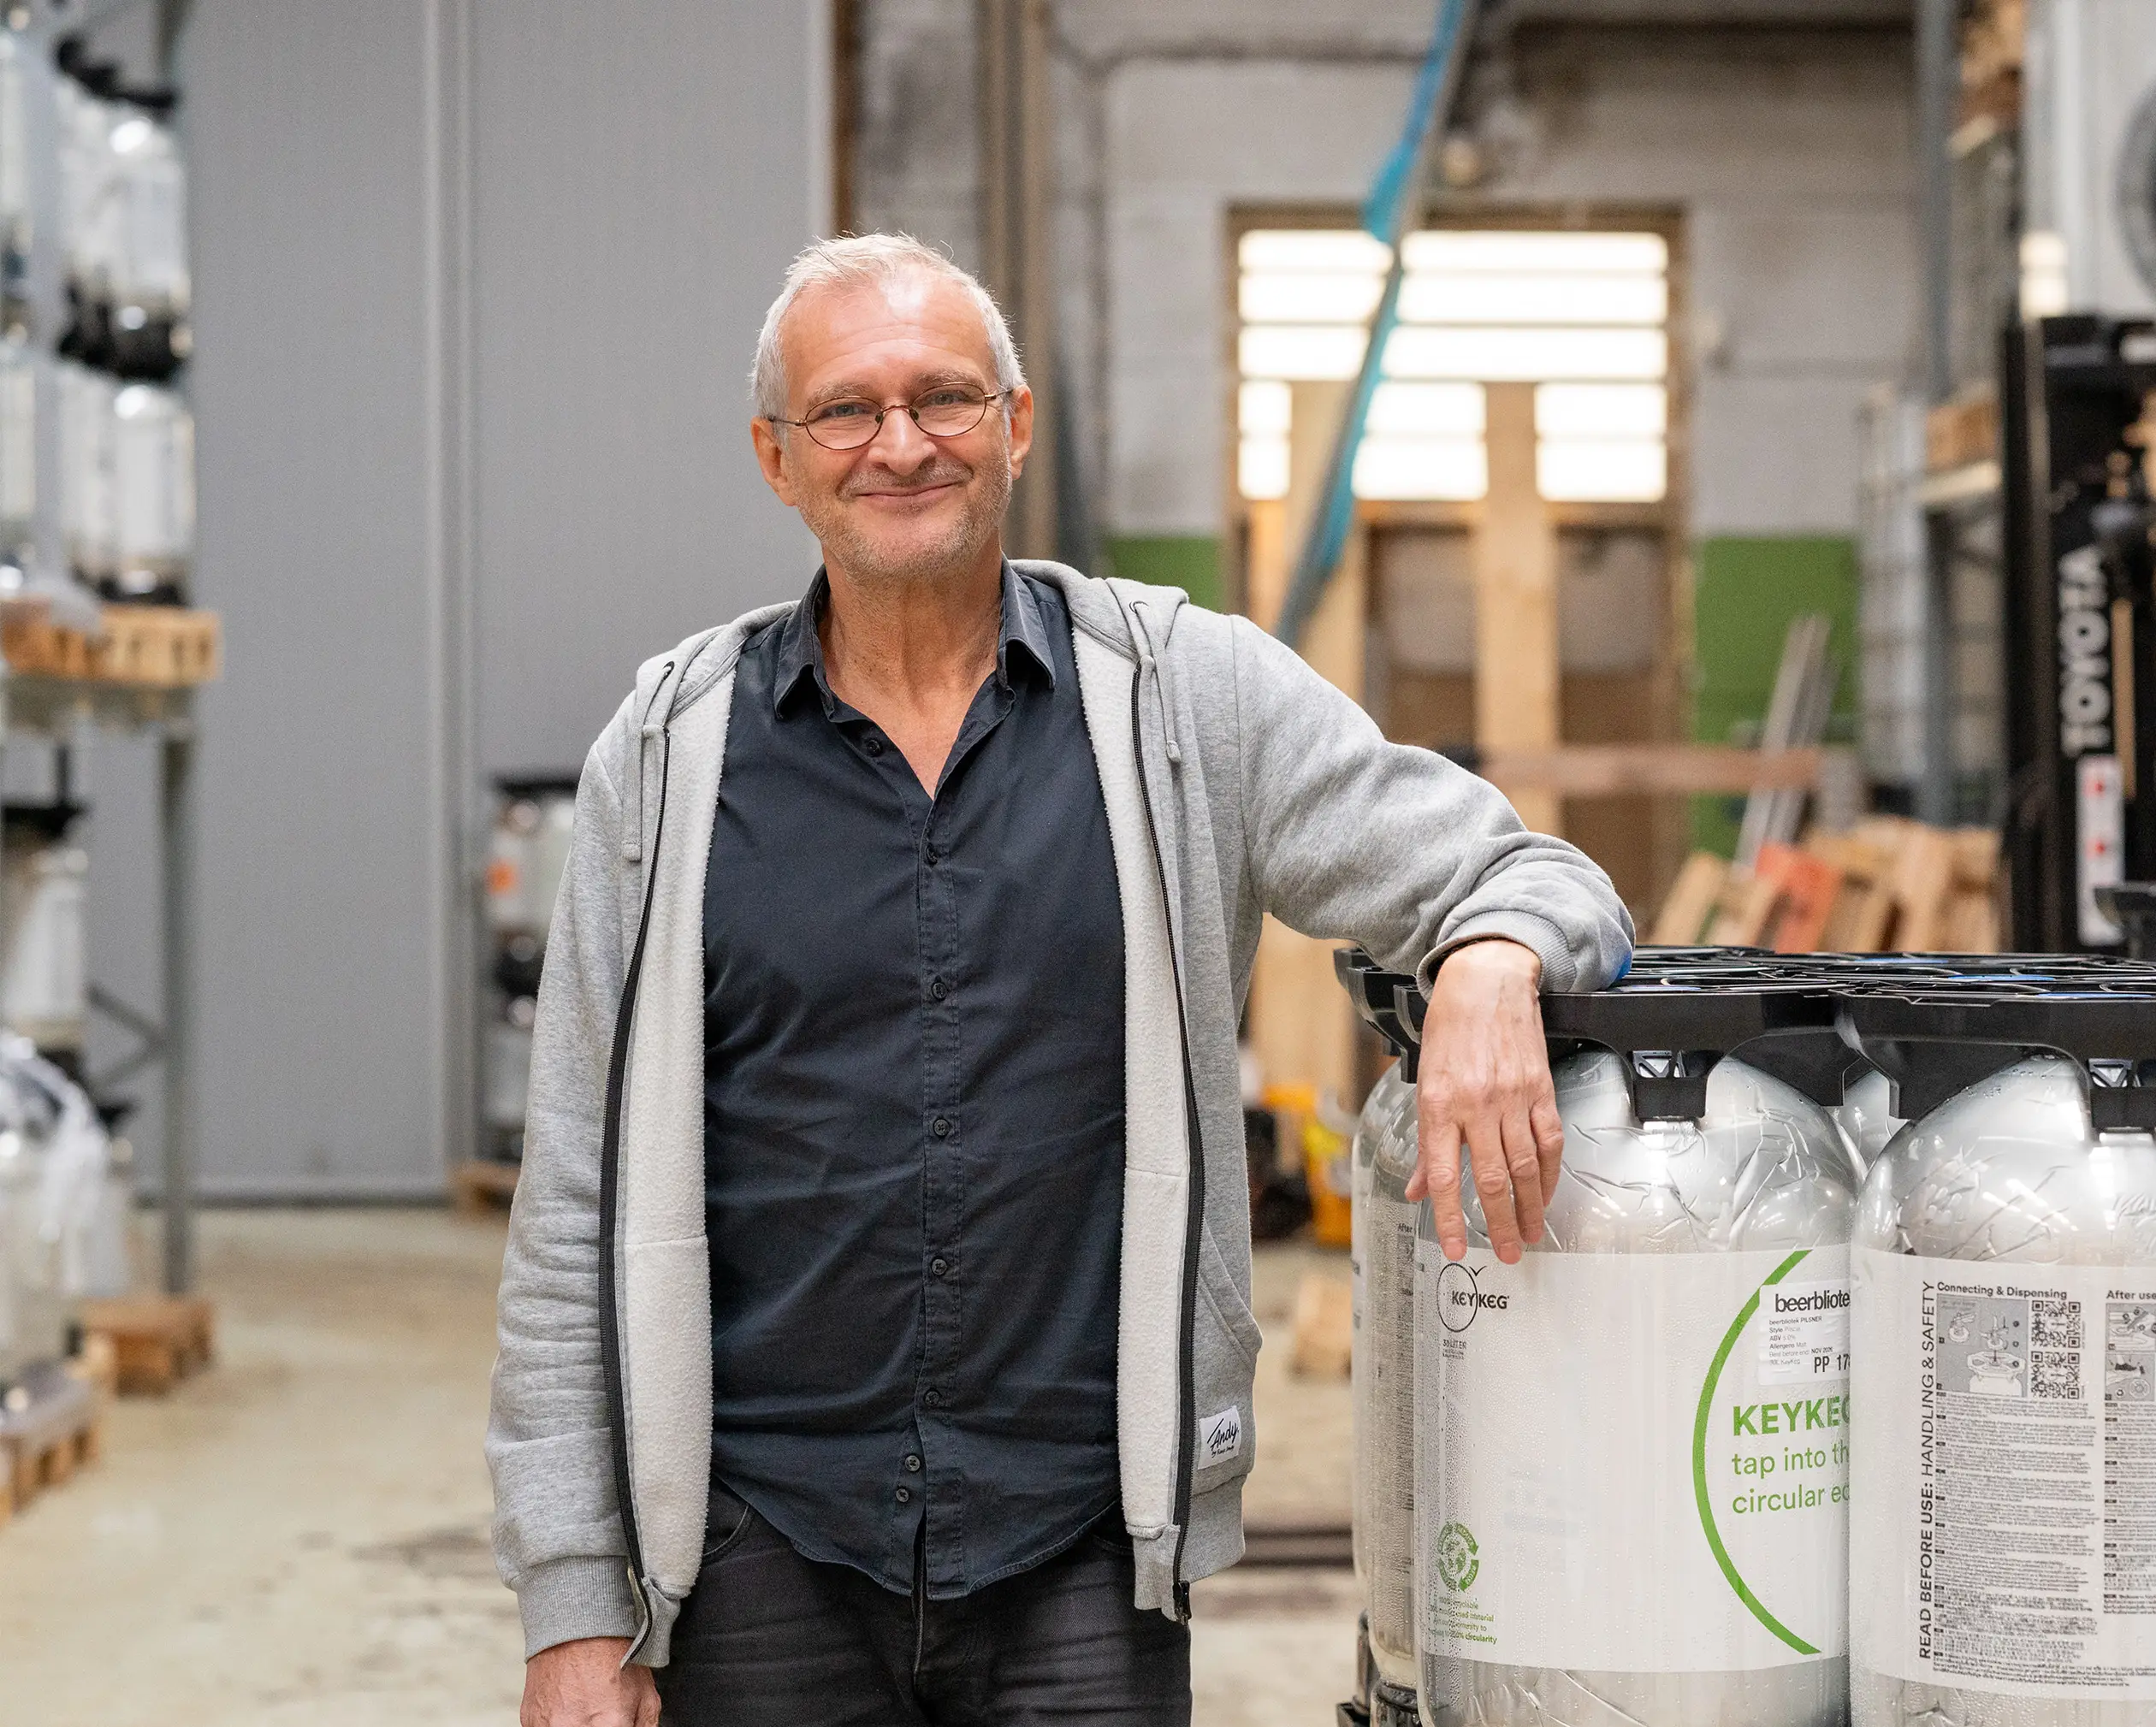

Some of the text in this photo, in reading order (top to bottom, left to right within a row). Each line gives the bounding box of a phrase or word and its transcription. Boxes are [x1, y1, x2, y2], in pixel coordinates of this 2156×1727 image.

[2058, 545, 2111, 758] TOYOTA
[1937, 1281, 2067, 1300] Connecting & Dispensing
[2106, 1289, 2156, 1300] After use
[1814, 1355, 1830, 1373] PP
[1732, 1453, 1775, 1479] tap
[1784, 1446, 1826, 1471] into
[1919, 1281, 1934, 1659] READ BEFORE USE: HANDLING & SAFETY
[1732, 1484, 1825, 1513] circular
[1465, 1632, 1497, 1644] circularity
